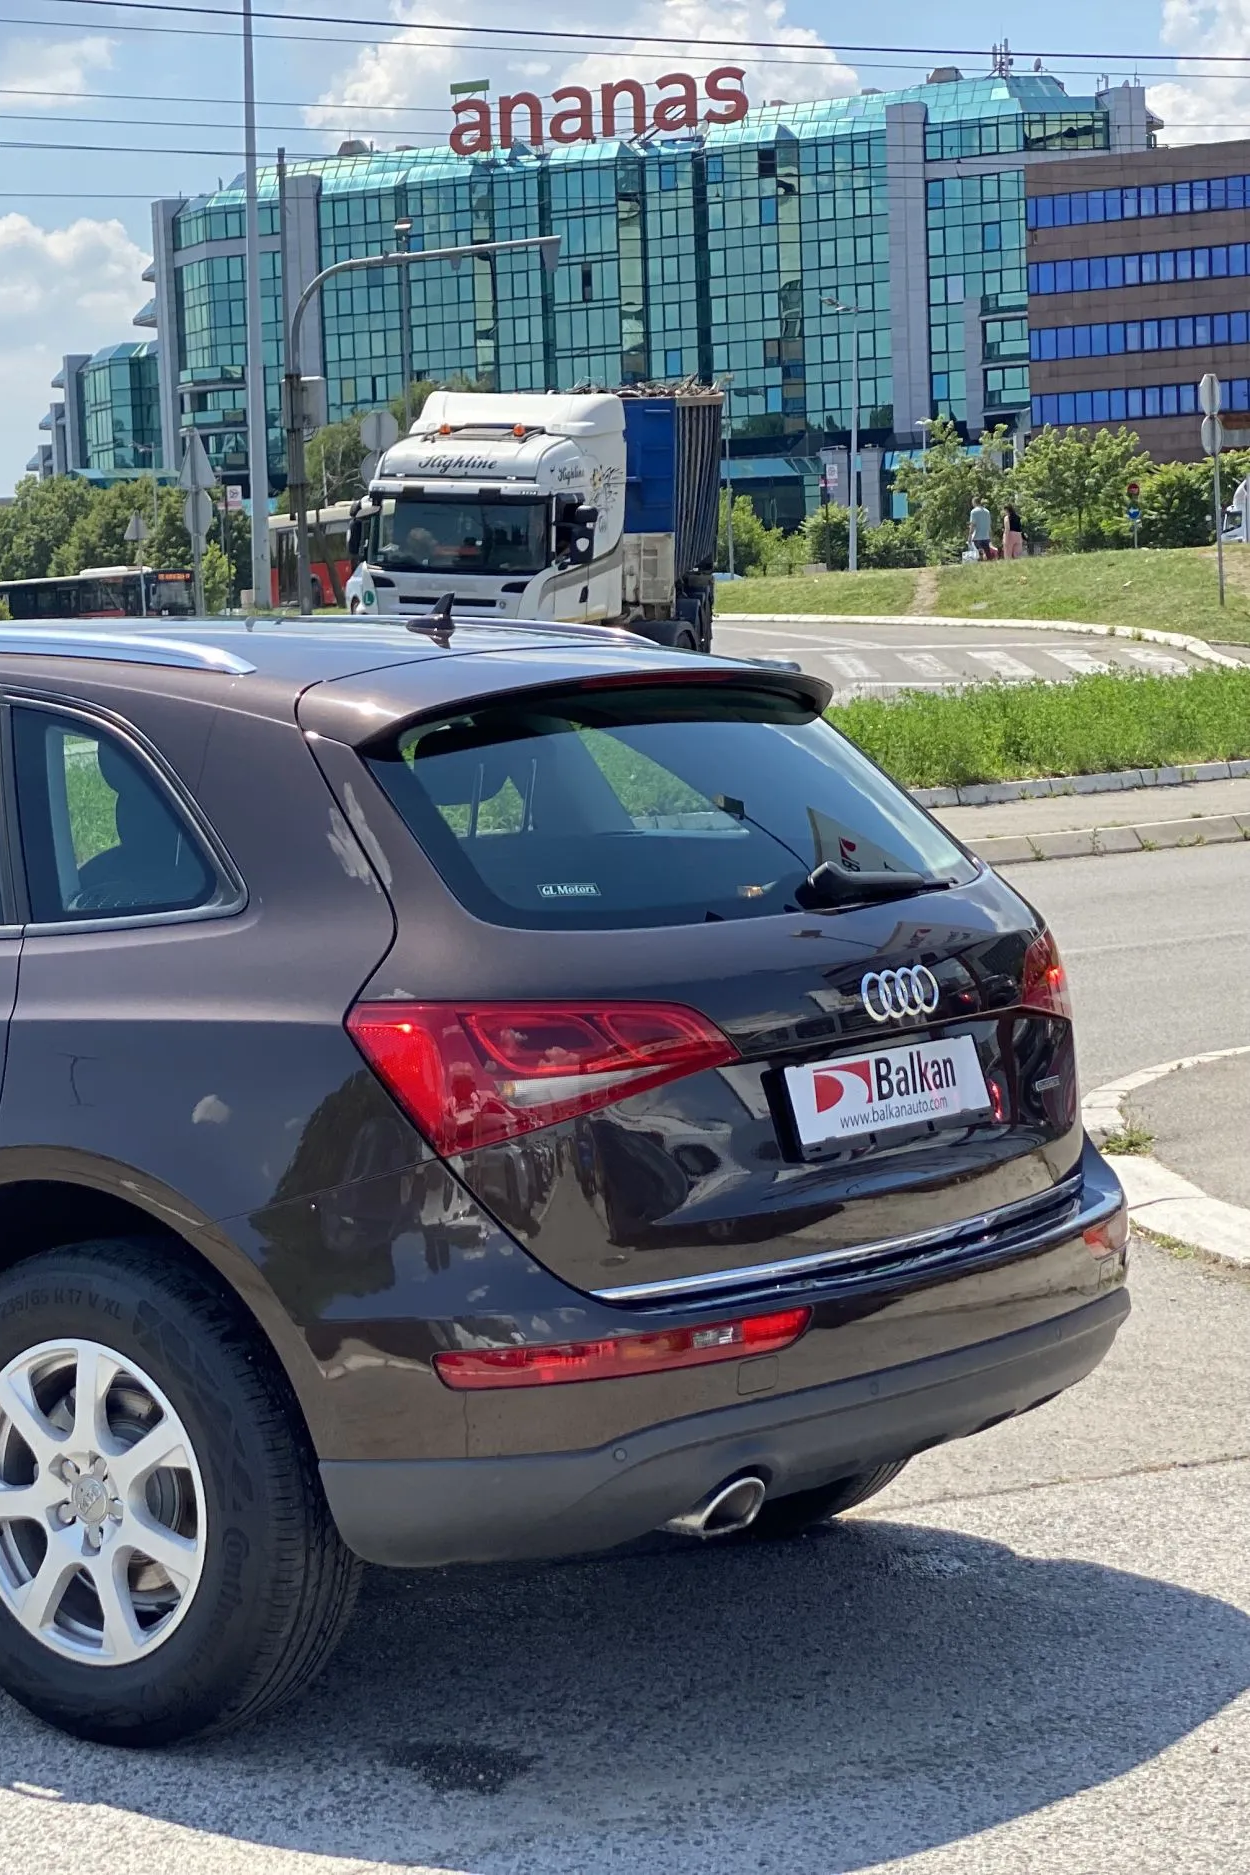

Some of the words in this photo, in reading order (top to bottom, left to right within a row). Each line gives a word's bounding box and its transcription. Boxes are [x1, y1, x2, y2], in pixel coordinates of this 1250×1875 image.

[418, 454, 499, 474] Highline
[557, 884, 596, 895] Motors
[874, 1050, 957, 1102] Balkan
[839, 1095, 948, 1130] www.balkanauto.com
